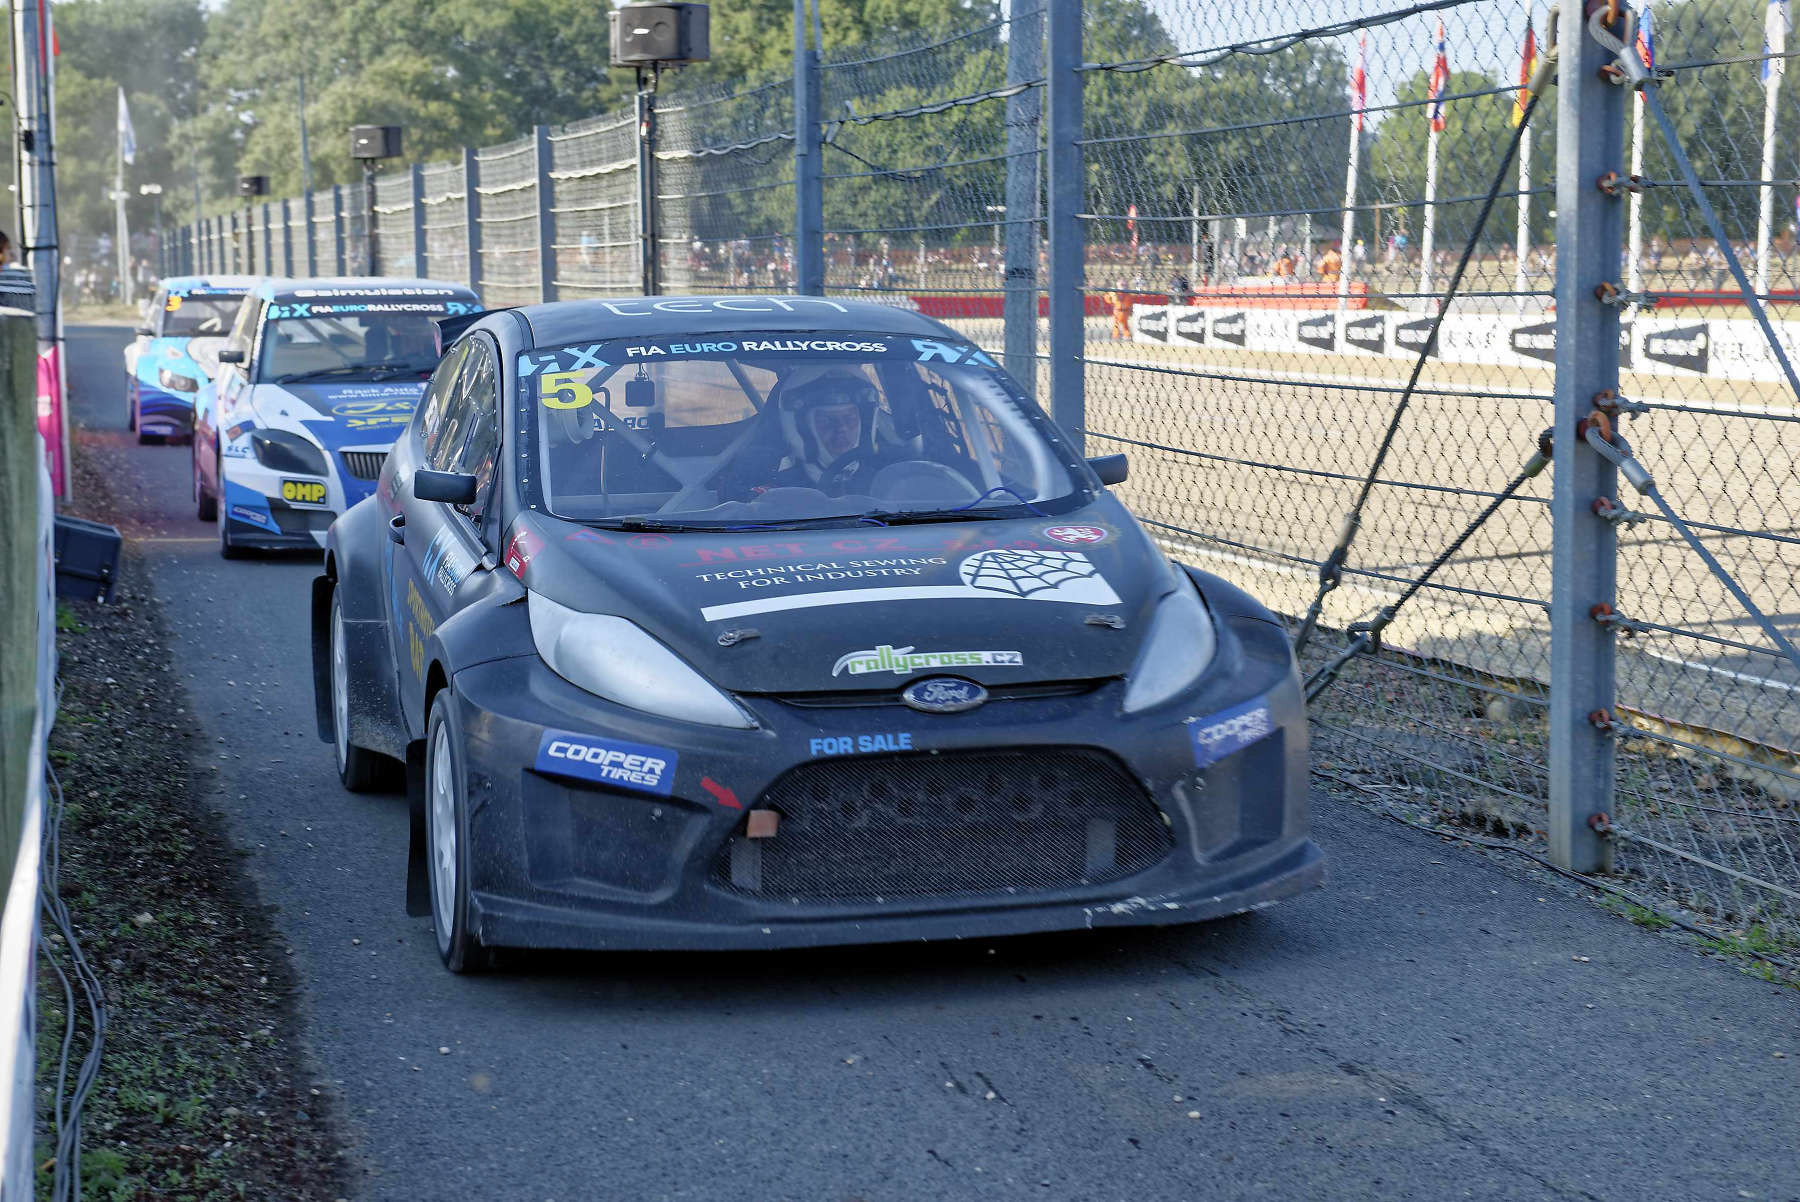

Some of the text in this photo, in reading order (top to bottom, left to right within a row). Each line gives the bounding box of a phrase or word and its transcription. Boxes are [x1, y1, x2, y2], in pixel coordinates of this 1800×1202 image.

[165, 295, 182, 312] 3
[311, 304, 444, 314] FIA EURO RALLYCROSS
[625, 340, 888, 358] FIA EURO RALLYCROSS
[540, 370, 594, 410] 5
[282, 481, 326, 502] OMP
[695, 556, 948, 583] TECHNICAL SEWING
[737, 565, 923, 590] FOR INDUSTRY
[849, 646, 1021, 674] rallycross.cz
[922, 682, 970, 703] Ford
[809, 732, 913, 756] FOR SALE
[547, 740, 667, 776] COOPER
[599, 764, 661, 787] TIRES
